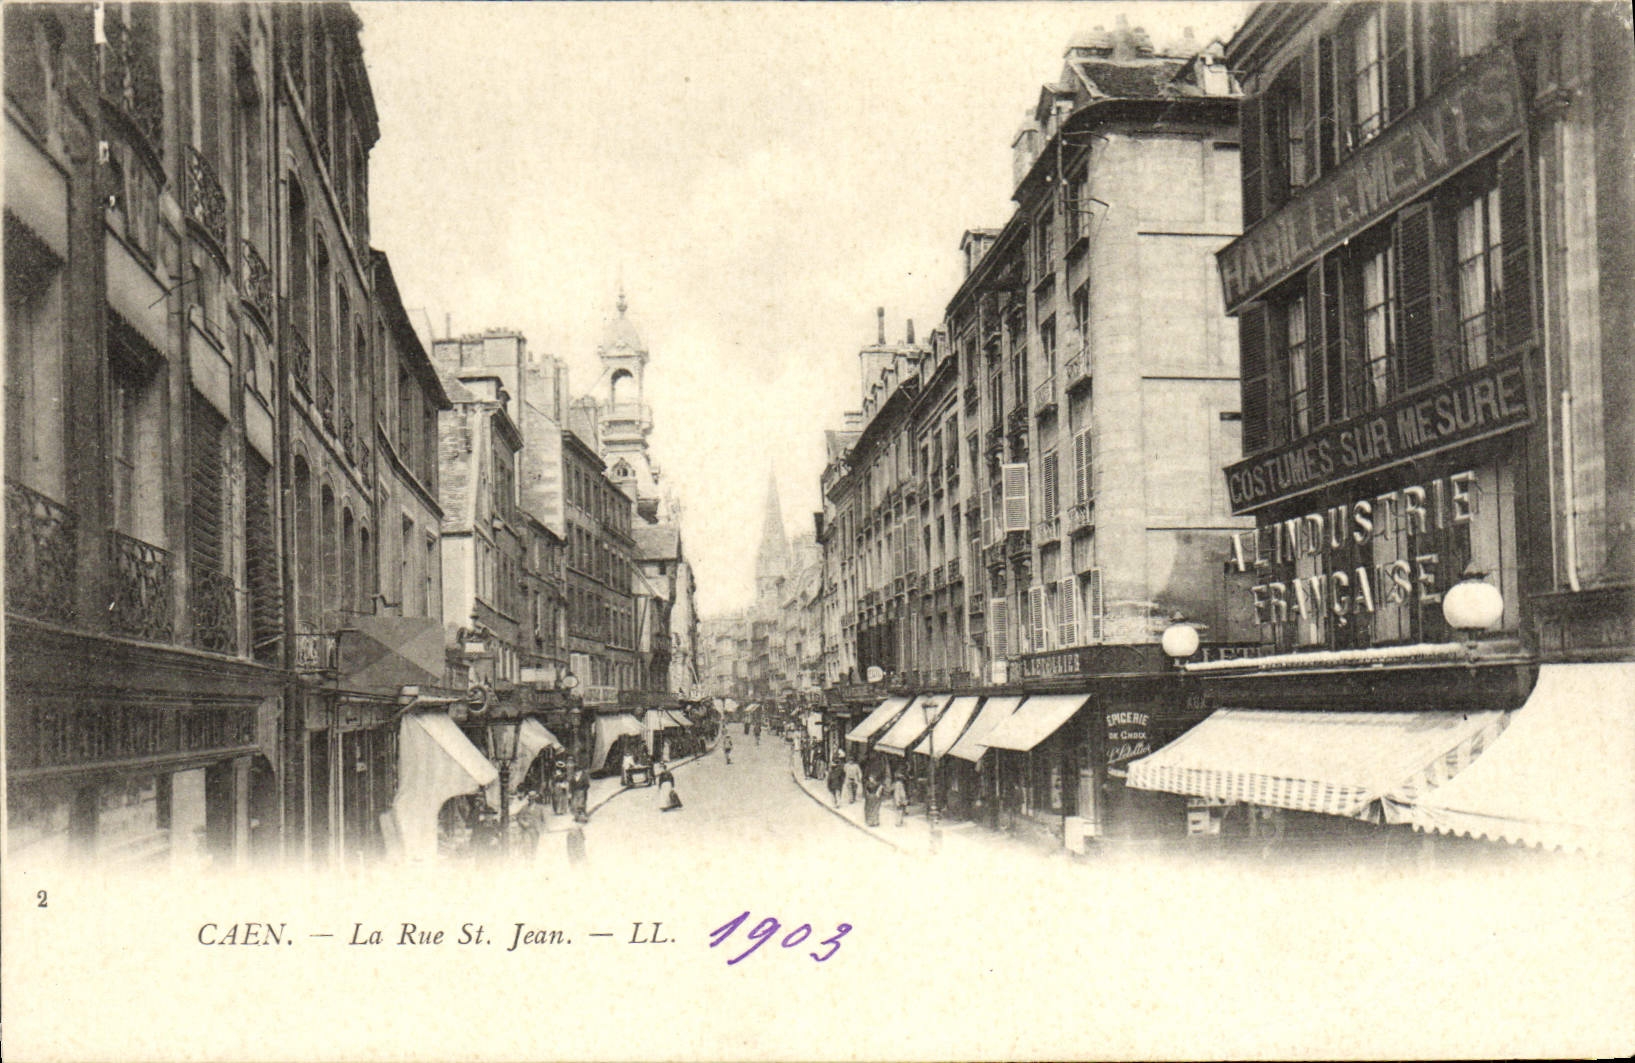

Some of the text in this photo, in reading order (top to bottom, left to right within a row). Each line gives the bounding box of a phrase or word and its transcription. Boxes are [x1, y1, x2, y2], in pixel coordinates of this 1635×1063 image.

[1229, 366, 1526, 504] COSTUMES SUR MESURE
[1251, 554, 1442, 627] FRANÇAISE
[709, 911, 854, 967] 1903
